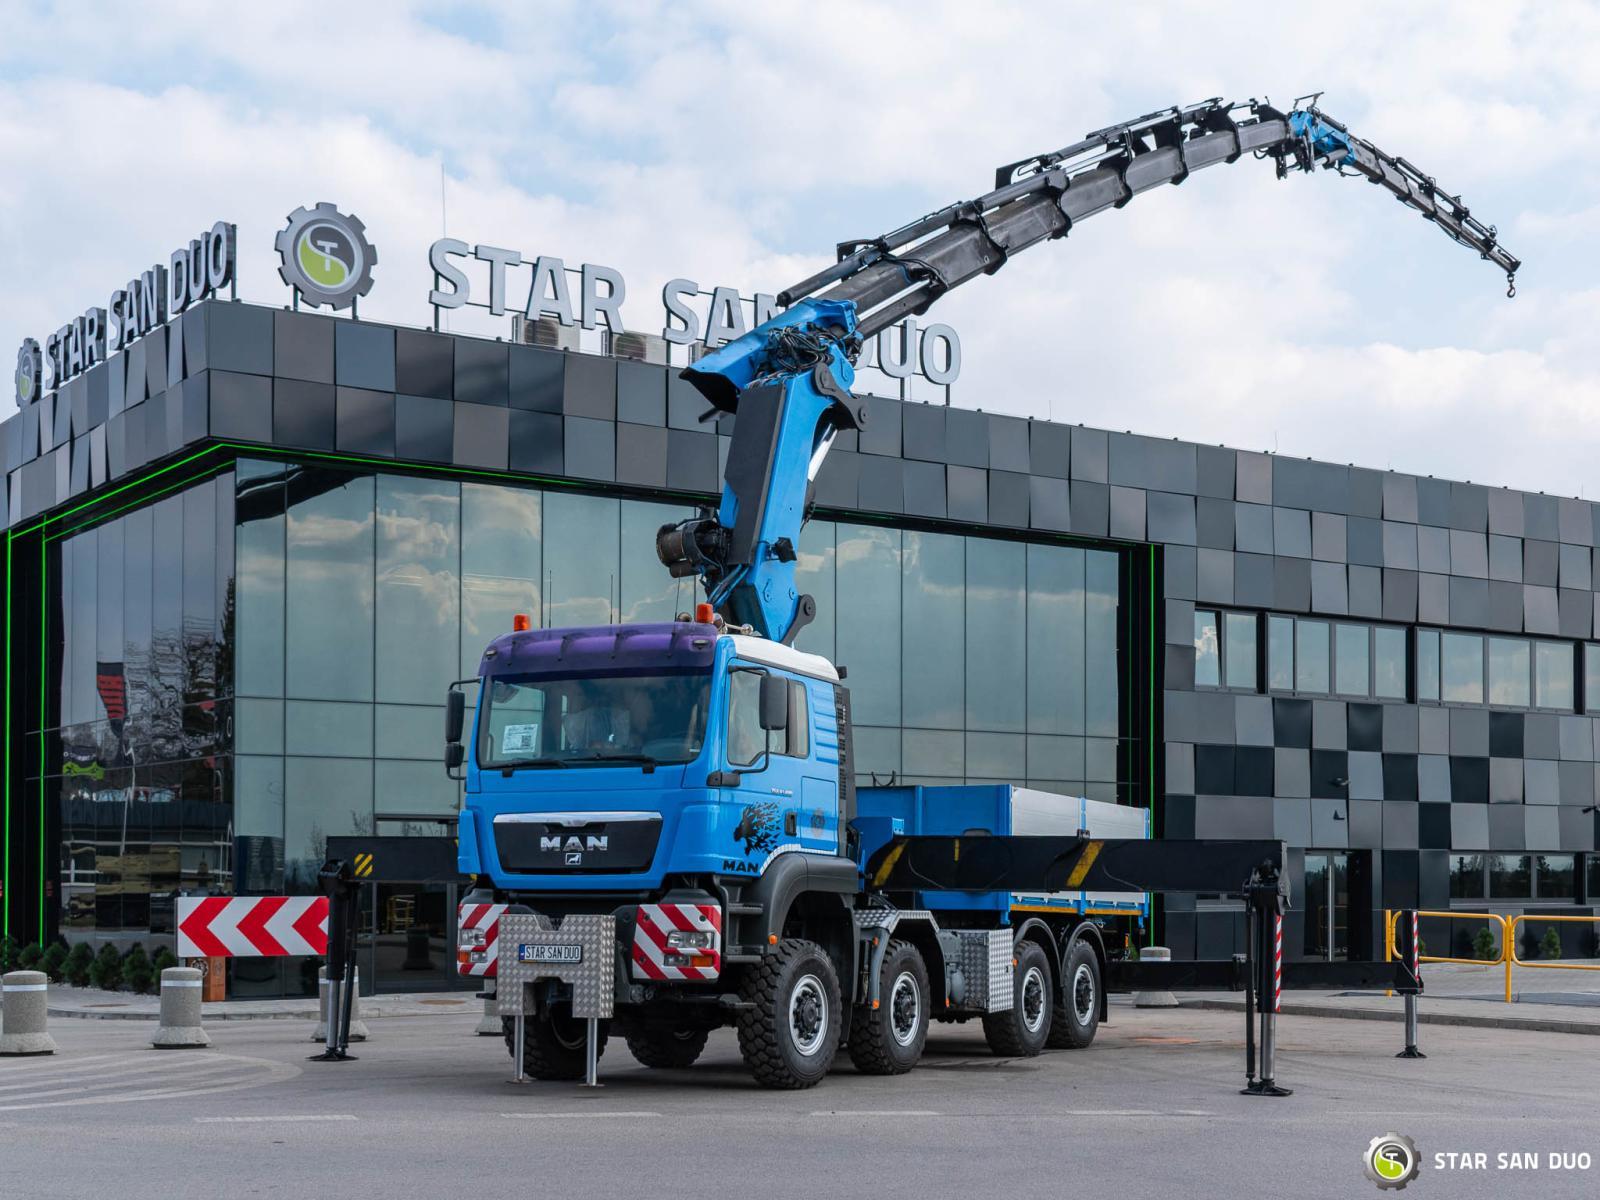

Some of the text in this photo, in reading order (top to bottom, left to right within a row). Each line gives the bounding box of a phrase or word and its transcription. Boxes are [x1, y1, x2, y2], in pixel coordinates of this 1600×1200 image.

[46, 220, 233, 390] STAR SAN DUO
[429, 237, 626, 335] STAR
[852, 318, 962, 386] UO
[540, 835, 609, 852] MAN
[722, 859, 760, 873] MAN
[525, 946, 580, 959] STAR SAN DUO
